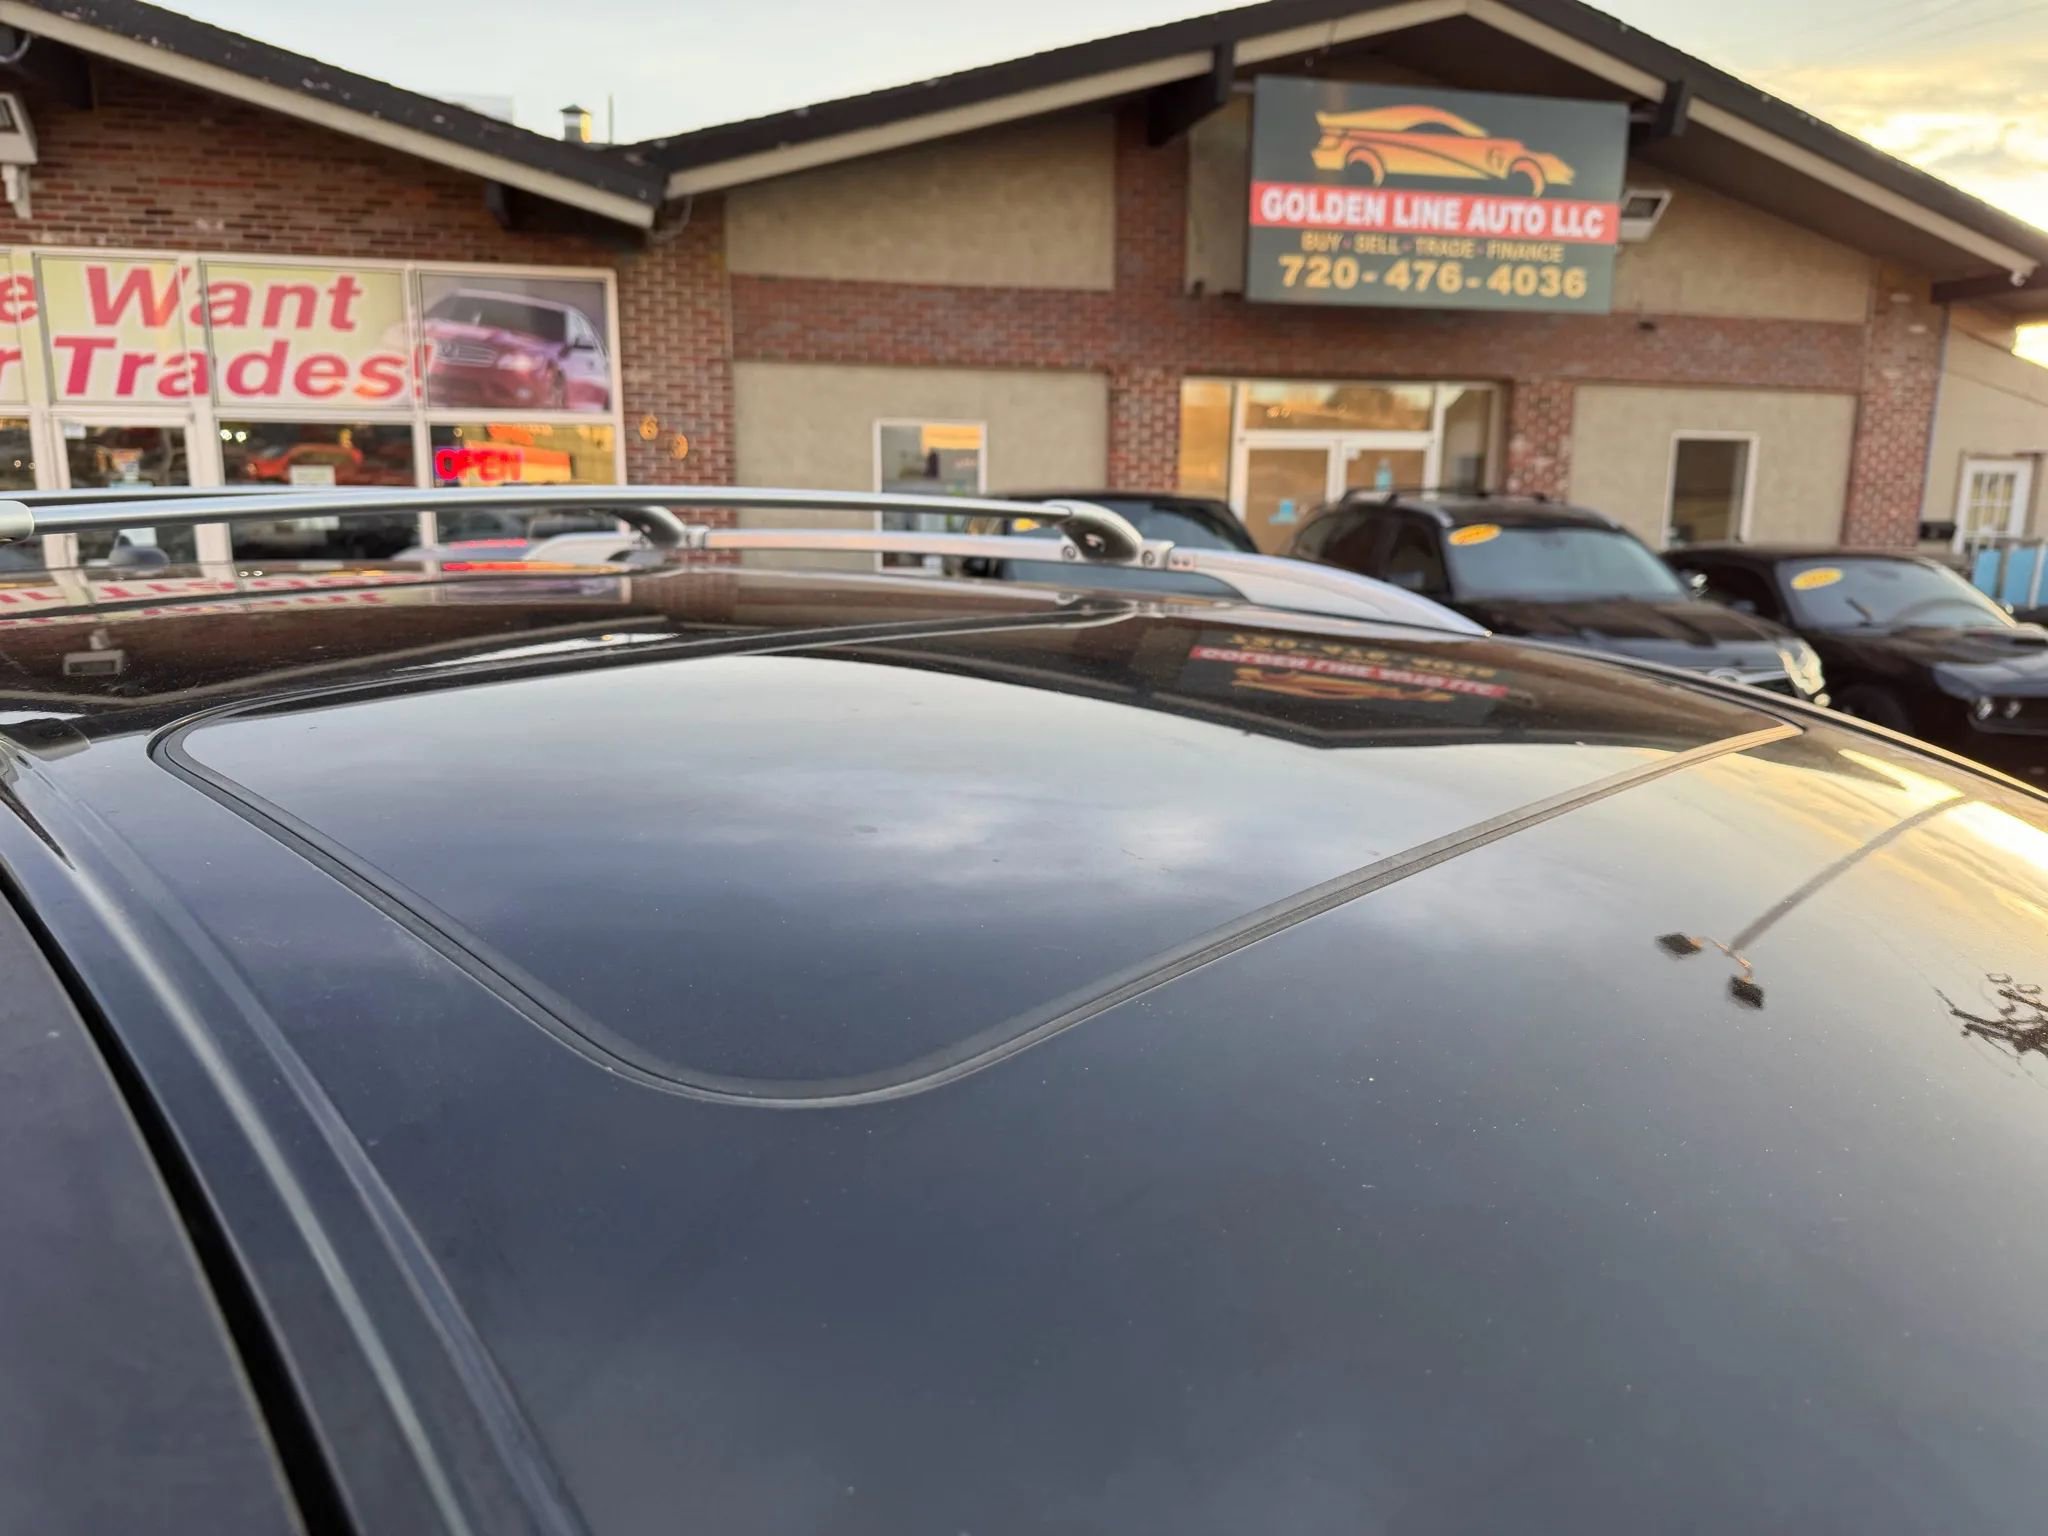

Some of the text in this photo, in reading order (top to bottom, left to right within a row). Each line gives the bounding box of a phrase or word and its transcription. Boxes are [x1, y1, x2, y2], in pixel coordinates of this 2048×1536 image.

[1261, 187, 1605, 239] GOLDEN LINE AUTO LLC
[1301, 230, 1565, 263] BUY SELL TRADE FINANCE
[86, 266, 362, 331] Want
[435, 449, 523, 481] OPEN
